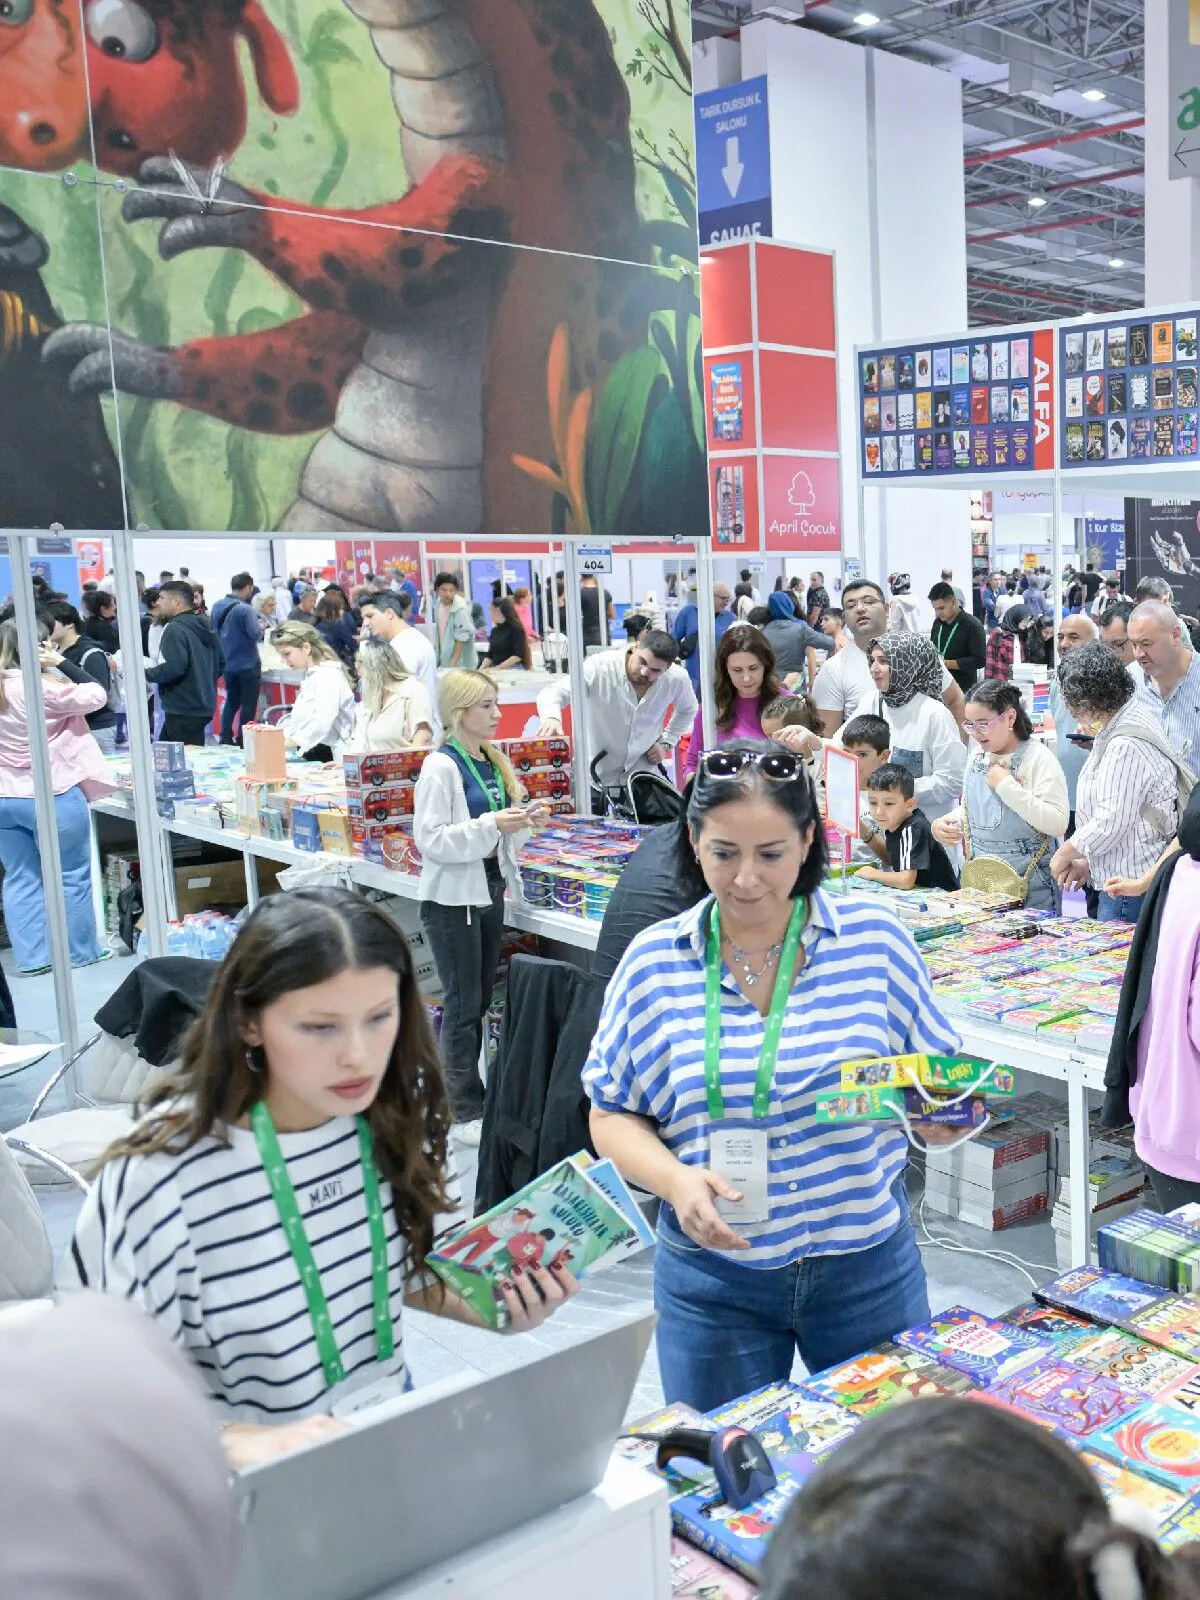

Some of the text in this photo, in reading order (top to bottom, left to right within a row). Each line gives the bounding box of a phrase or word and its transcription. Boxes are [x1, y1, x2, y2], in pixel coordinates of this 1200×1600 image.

[1034, 357, 1050, 445] ALFA
[769, 519, 837, 537] April Çocuk
[583, 560, 605, 570] 404
